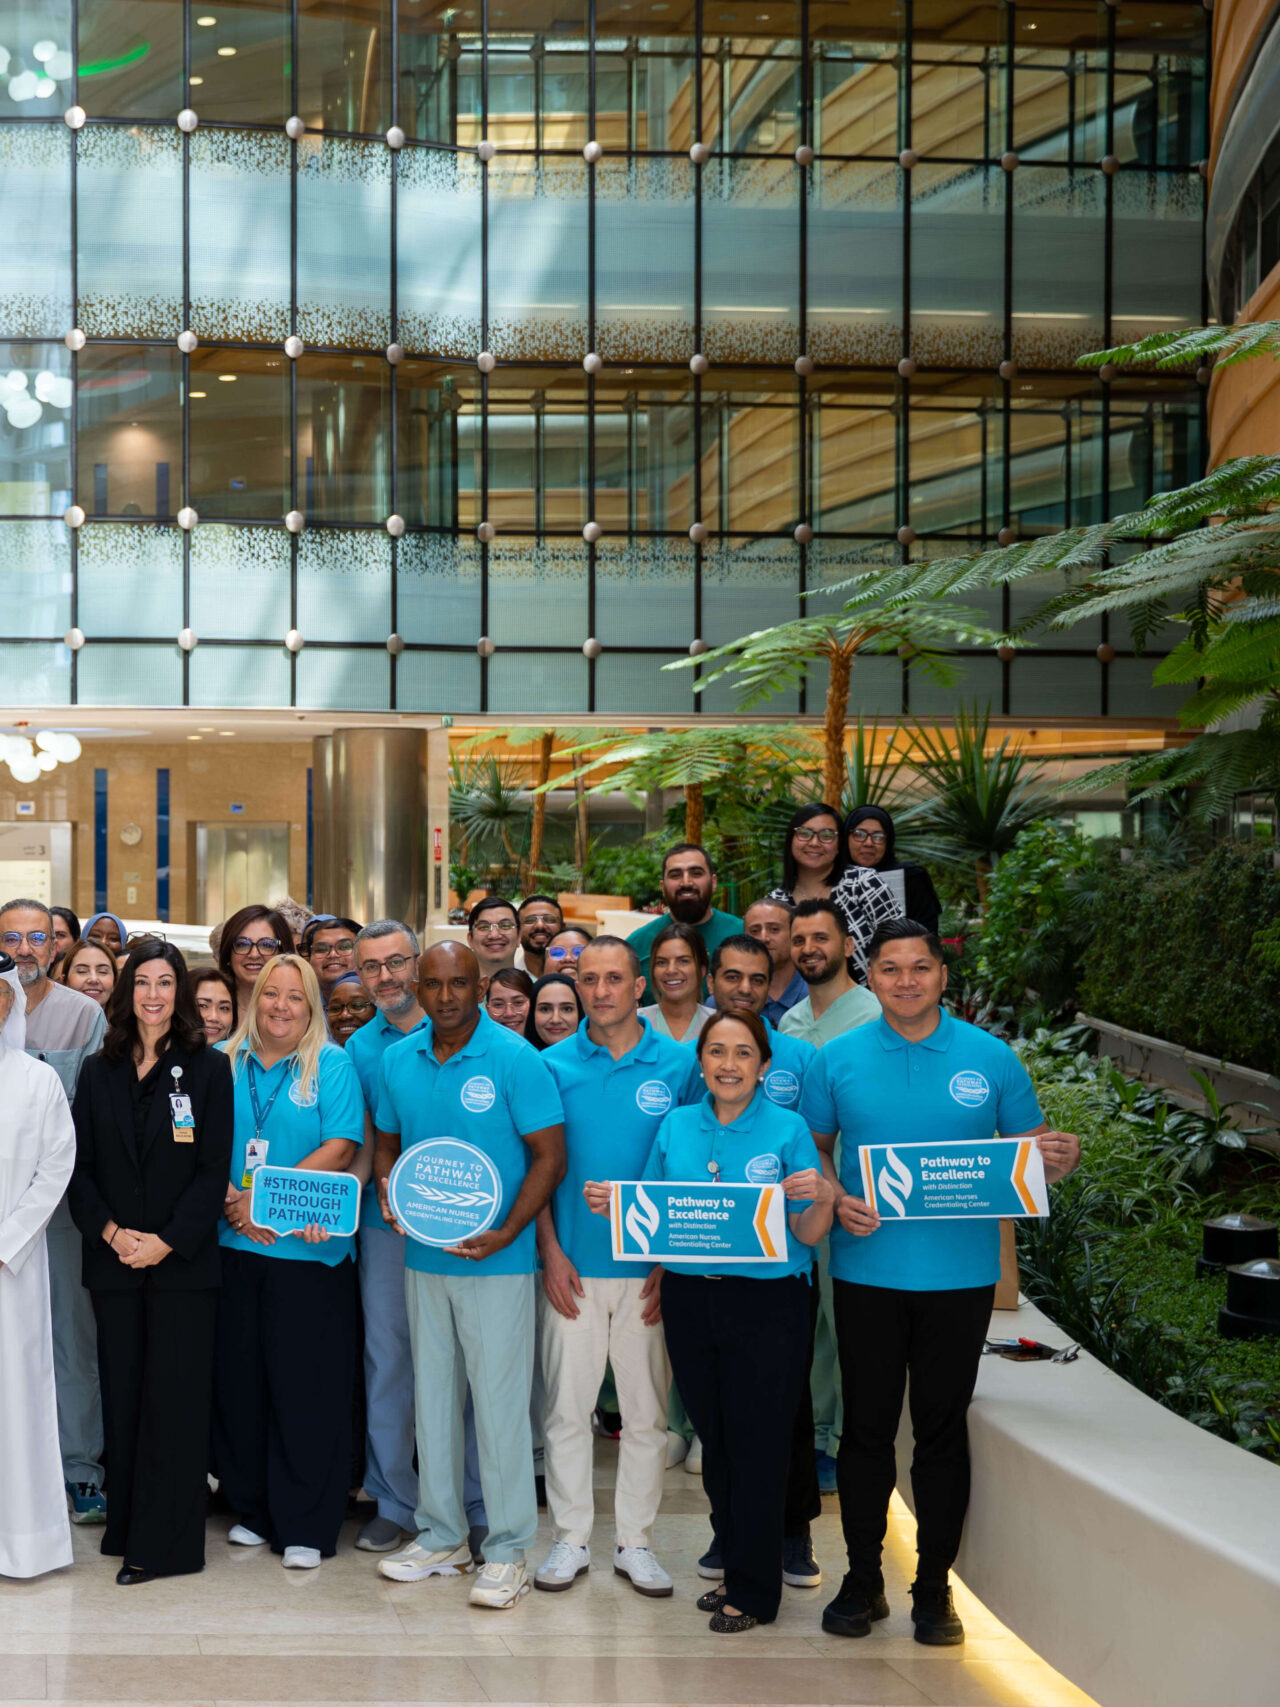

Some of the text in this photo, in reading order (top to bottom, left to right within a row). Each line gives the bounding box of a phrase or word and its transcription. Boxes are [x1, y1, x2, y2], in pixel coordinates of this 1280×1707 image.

[417, 1155, 483, 1172] JOURNEY TO
[920, 1155, 991, 1168] Pathway to
[415, 1163, 482, 1182] PATHWAY
[921, 1169, 985, 1181] Excellence
[263, 1176, 349, 1196] #STRONGER
[428, 1174, 480, 1190] EXCELLENCE
[269, 1192, 341, 1210] THROUGH
[667, 1196, 736, 1210] Pathway to
[924, 1201, 968, 1209] Credentialing
[268, 1207, 341, 1225] PATHWAY
[405, 1210, 478, 1227] CREDENTIALING CENTER
[406, 1201, 480, 1220] AMERICAN NURSES
[668, 1209, 730, 1220] Excellence
[668, 1240, 710, 1249] Credentialing
